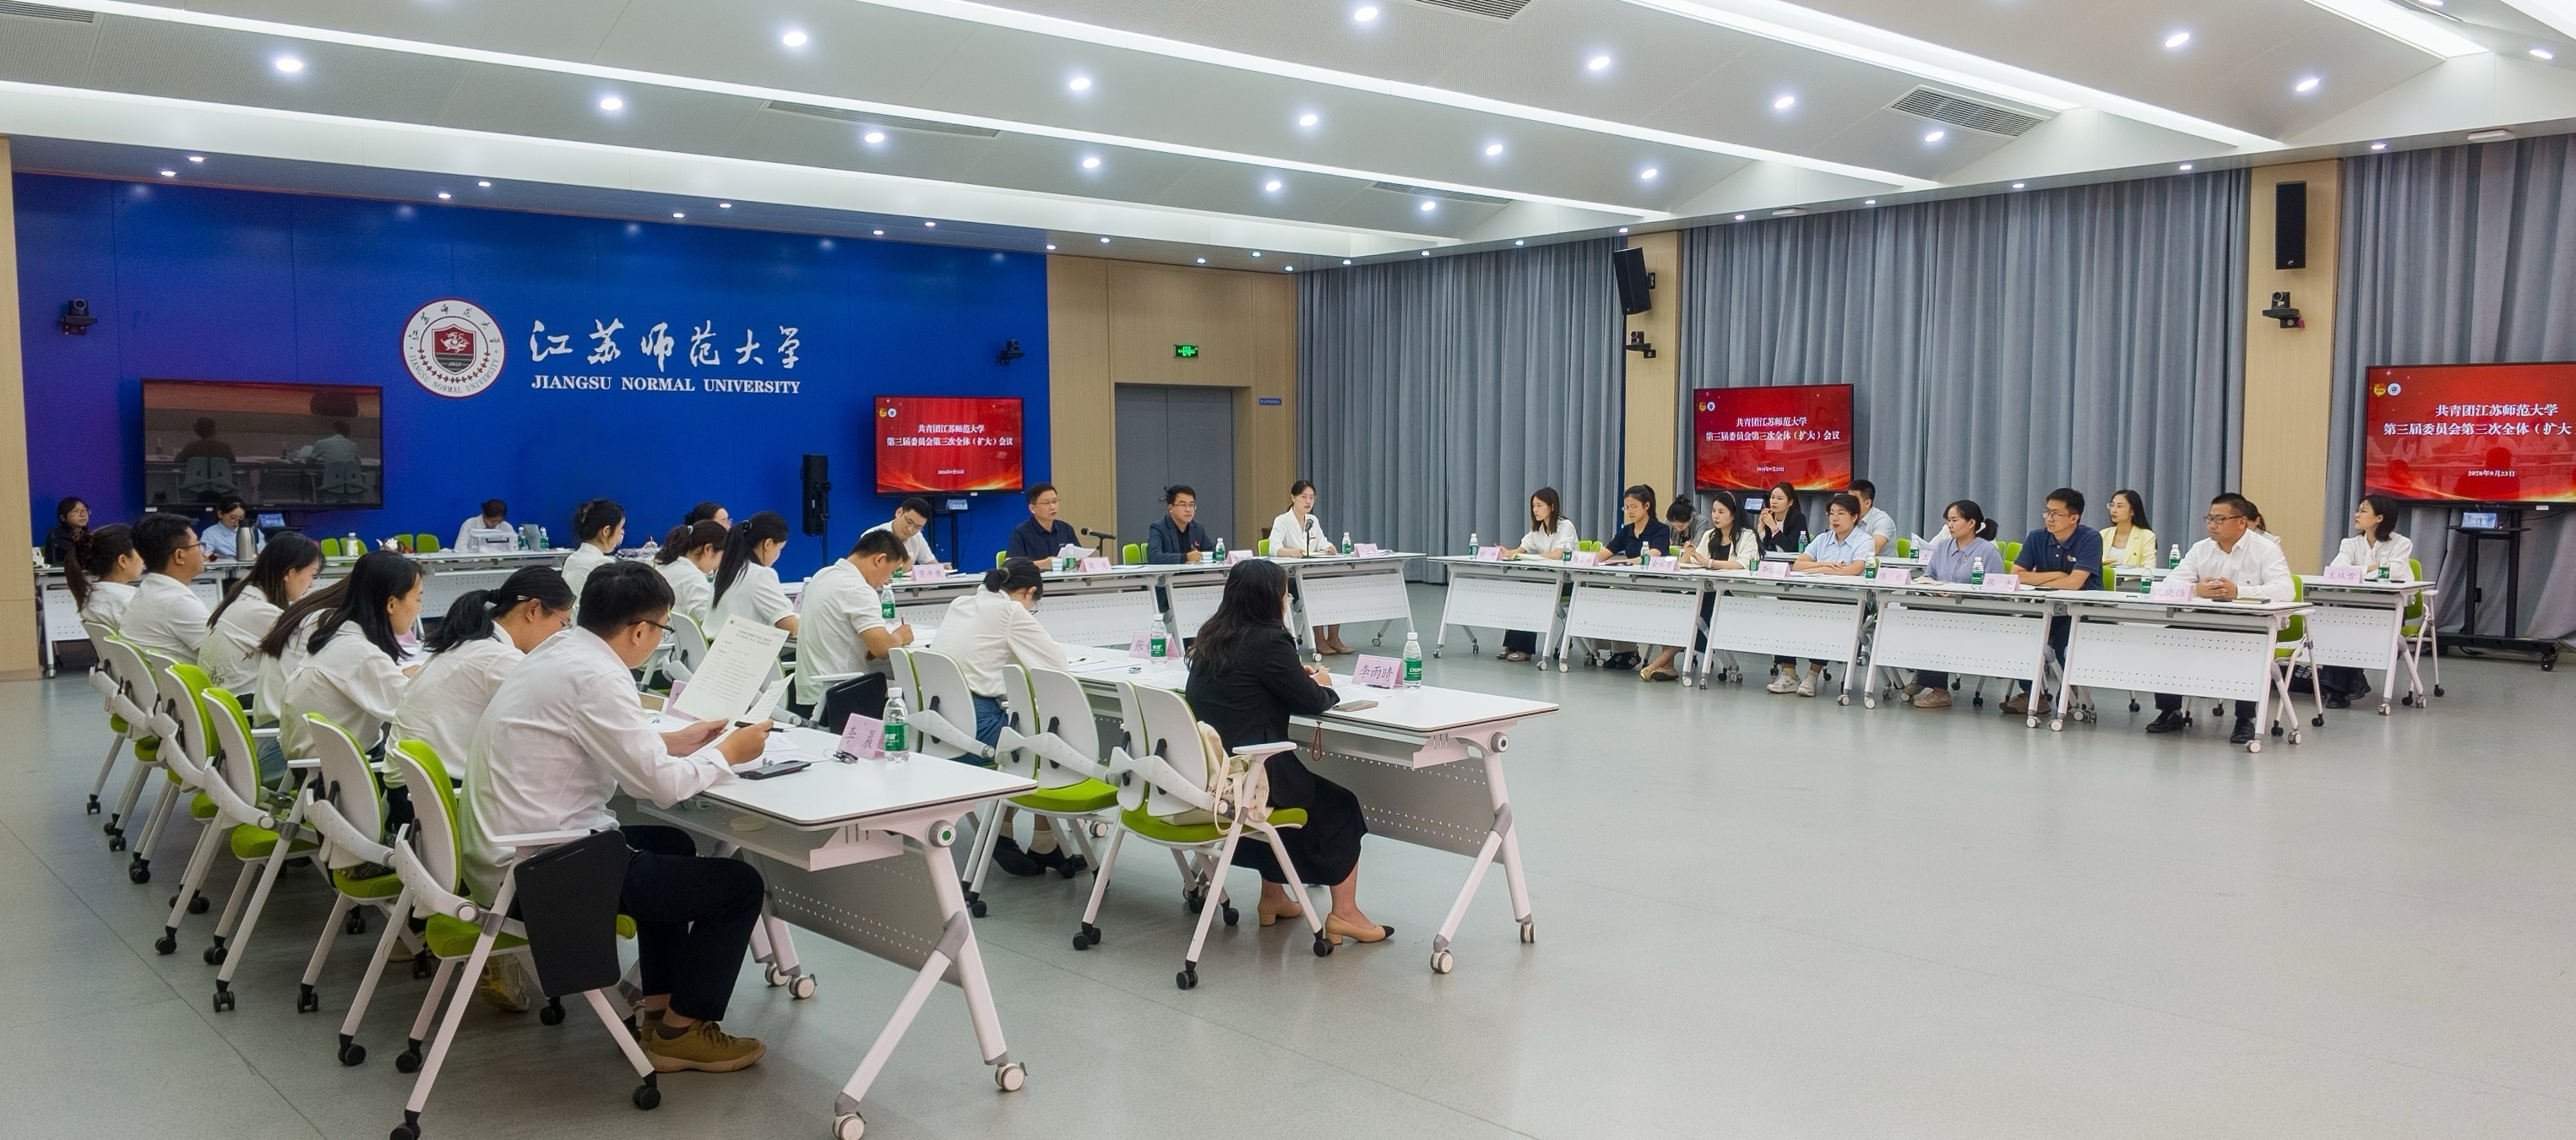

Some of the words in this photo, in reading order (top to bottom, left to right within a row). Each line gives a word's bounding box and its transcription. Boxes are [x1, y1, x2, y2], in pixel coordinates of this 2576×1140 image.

[530, 318, 800, 372] 江苏师范大学
[432, 381, 462, 394] NORMAL
[531, 375, 611, 390] JIANGSU
[621, 377, 694, 391] NORMAL
[704, 379, 800, 394] UNIVERSITY
[2435, 404, 2558, 416] 共青团江苏师范大学
[1736, 416, 1807, 427] 共青团江苏师范大学
[2383, 422, 2576, 435] 第三届委员会第三次全体（扩大
[1359, 664, 1394, 681] 李雨晴
[845, 725, 875, 749] 李晨
